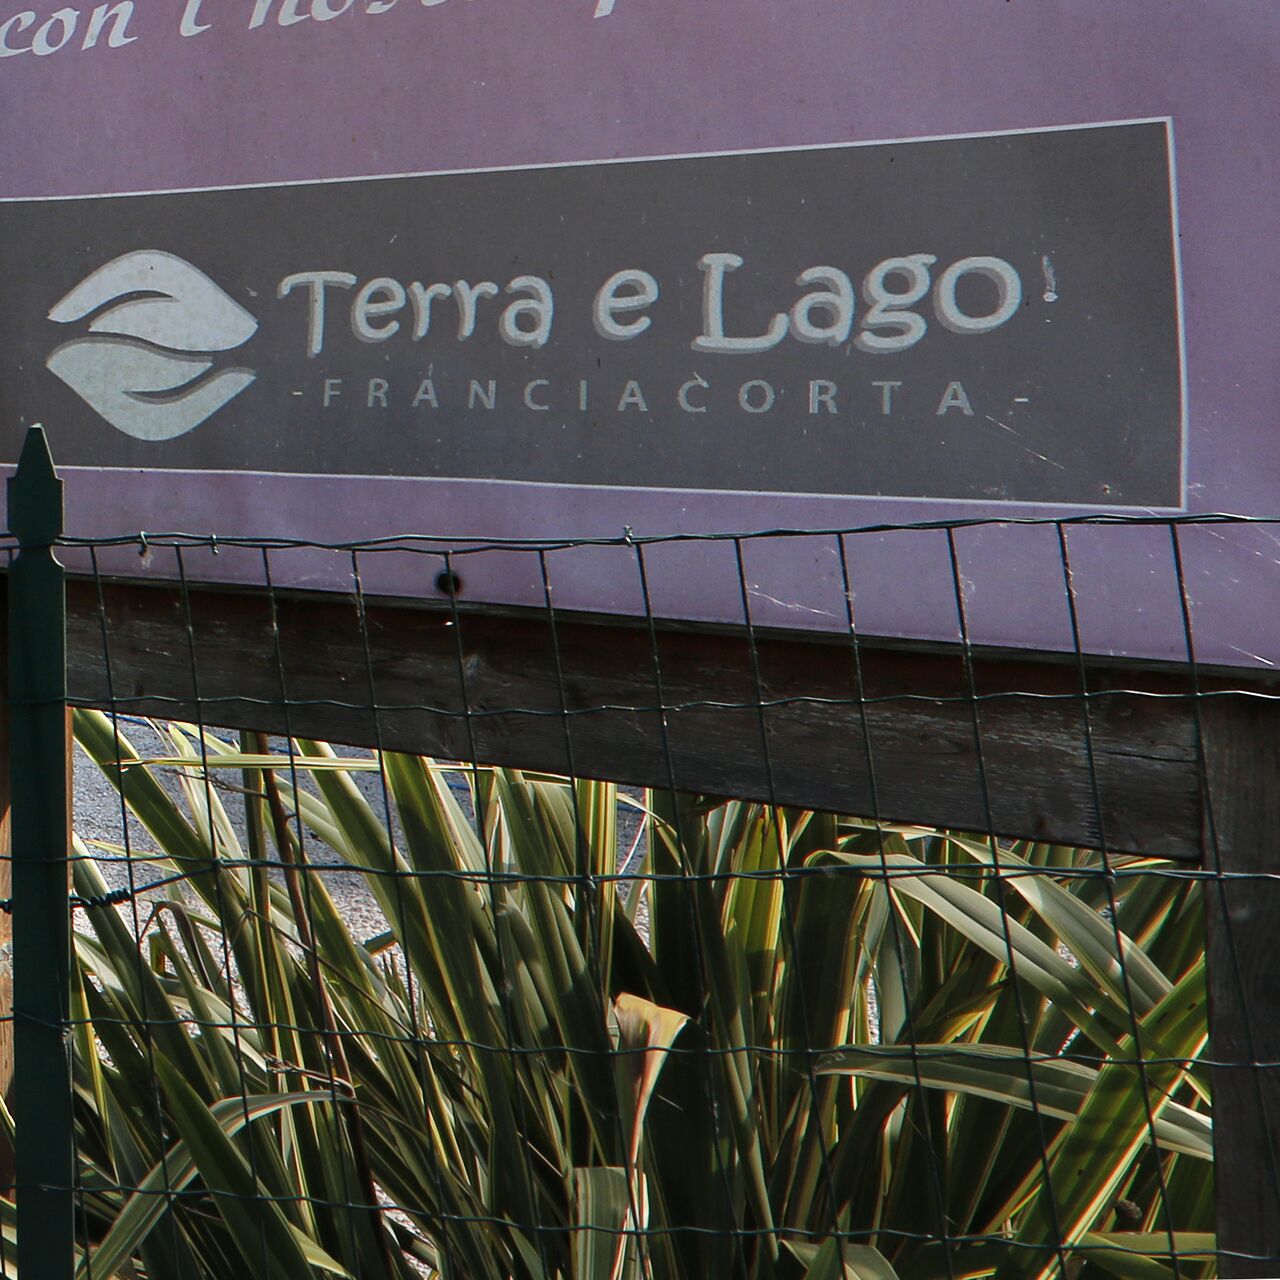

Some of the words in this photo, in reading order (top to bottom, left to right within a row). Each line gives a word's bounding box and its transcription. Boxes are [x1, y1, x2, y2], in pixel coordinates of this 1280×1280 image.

[277, 271, 554, 356] Terra
[592, 268, 660, 342] e
[690, 252, 1023, 354] Lago
